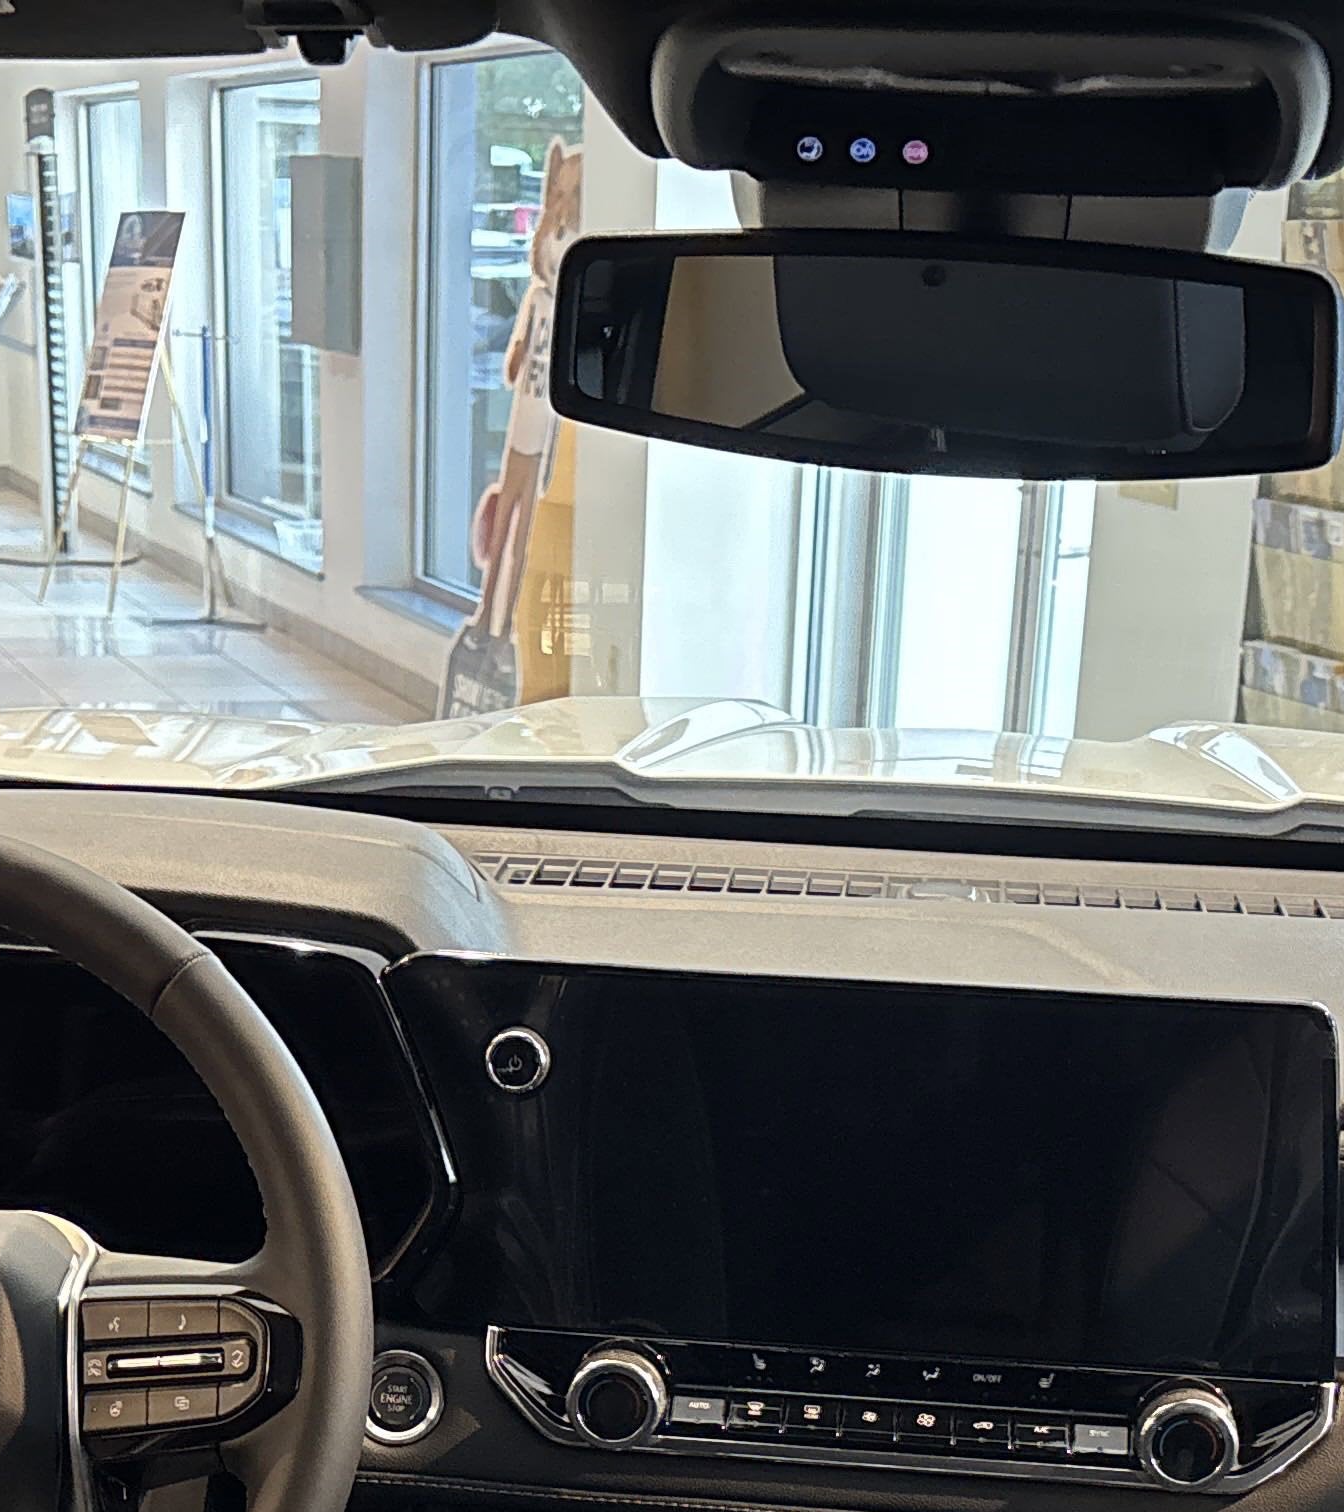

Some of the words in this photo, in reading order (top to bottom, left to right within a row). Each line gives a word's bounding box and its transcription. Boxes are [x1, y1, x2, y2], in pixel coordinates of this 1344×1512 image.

[387, 1384, 408, 1394] START
[380, 1393, 413, 1405] ENGINE
[688, 1401, 712, 1410] AUTO
